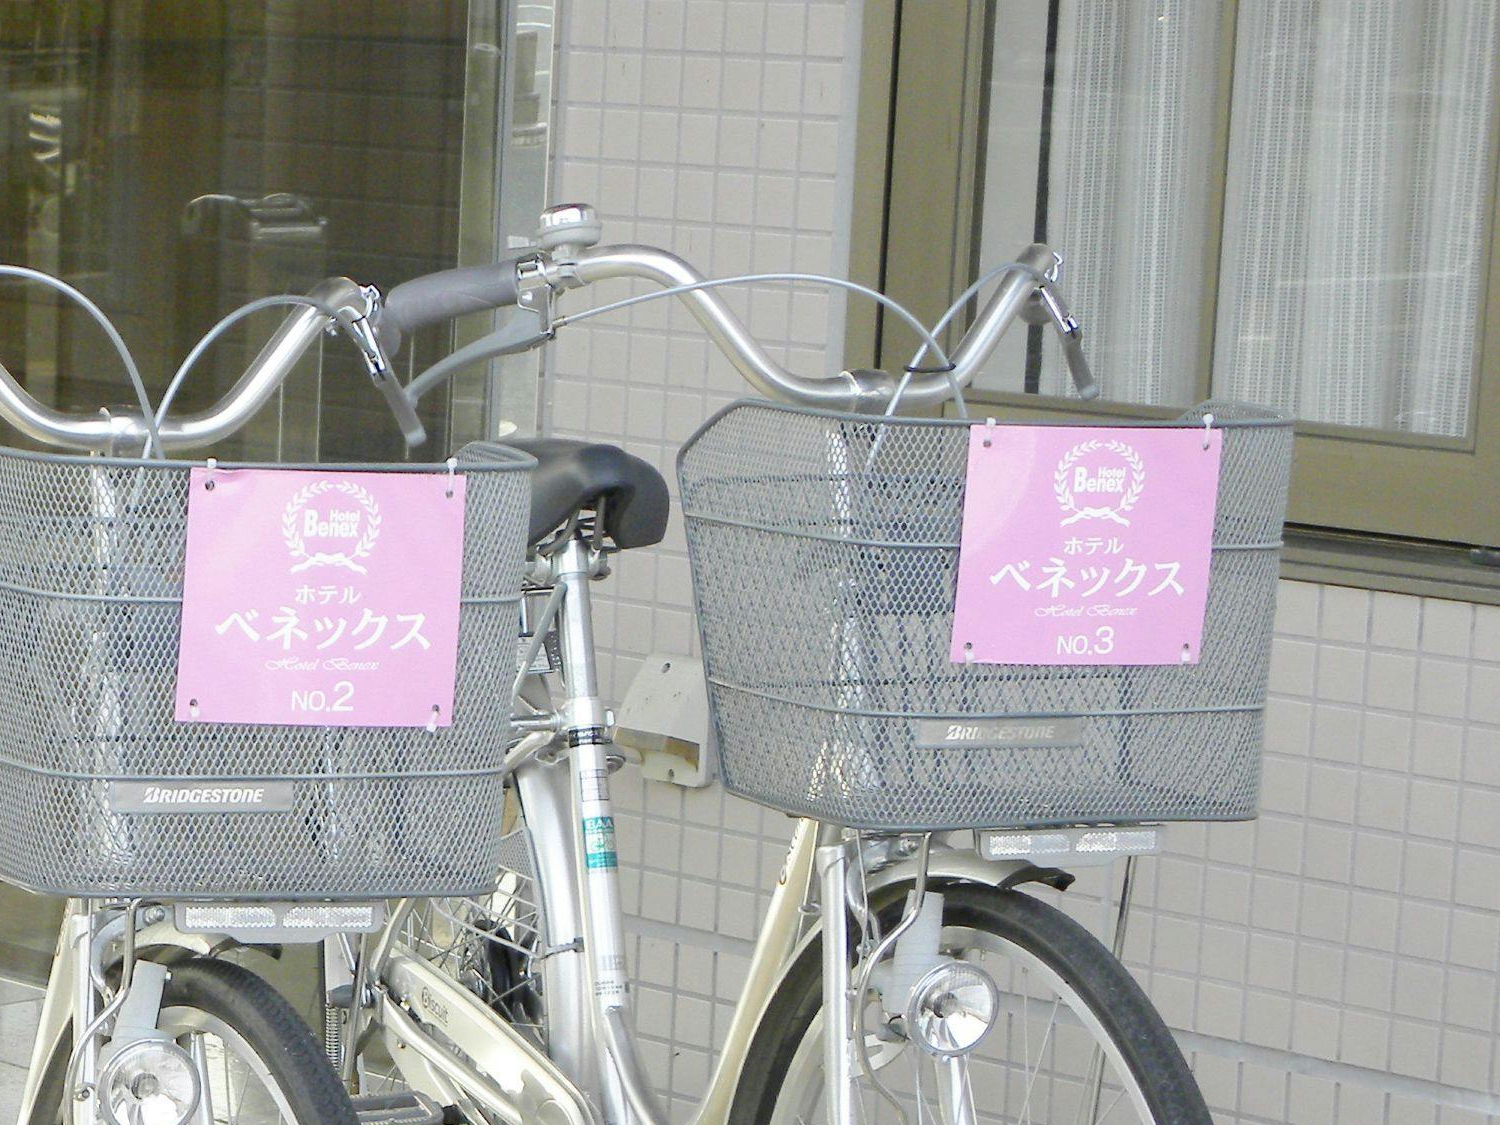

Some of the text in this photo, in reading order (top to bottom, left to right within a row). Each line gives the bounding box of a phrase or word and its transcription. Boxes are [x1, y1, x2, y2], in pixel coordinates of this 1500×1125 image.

[1074, 466, 1125, 493] Benex
[1098, 466, 1126, 478] Hotel
[304, 509, 359, 538] Benex
[330, 509, 360, 522] Hotel
[1064, 537, 1124, 555] ホテル
[989, 557, 1185, 598] ベネックス
[294, 584, 363, 605] ホテル
[1034, 604, 1083, 617] Hotel
[214, 606, 432, 650] ベネックス
[1056, 626, 1115, 655] NO.3
[265, 657, 380, 672] Hotel Benex
[291, 681, 355, 712] NO.2
[944, 724, 1056, 741] BRIDGESTONE
[142, 786, 265, 804] BRIDGESTONE
